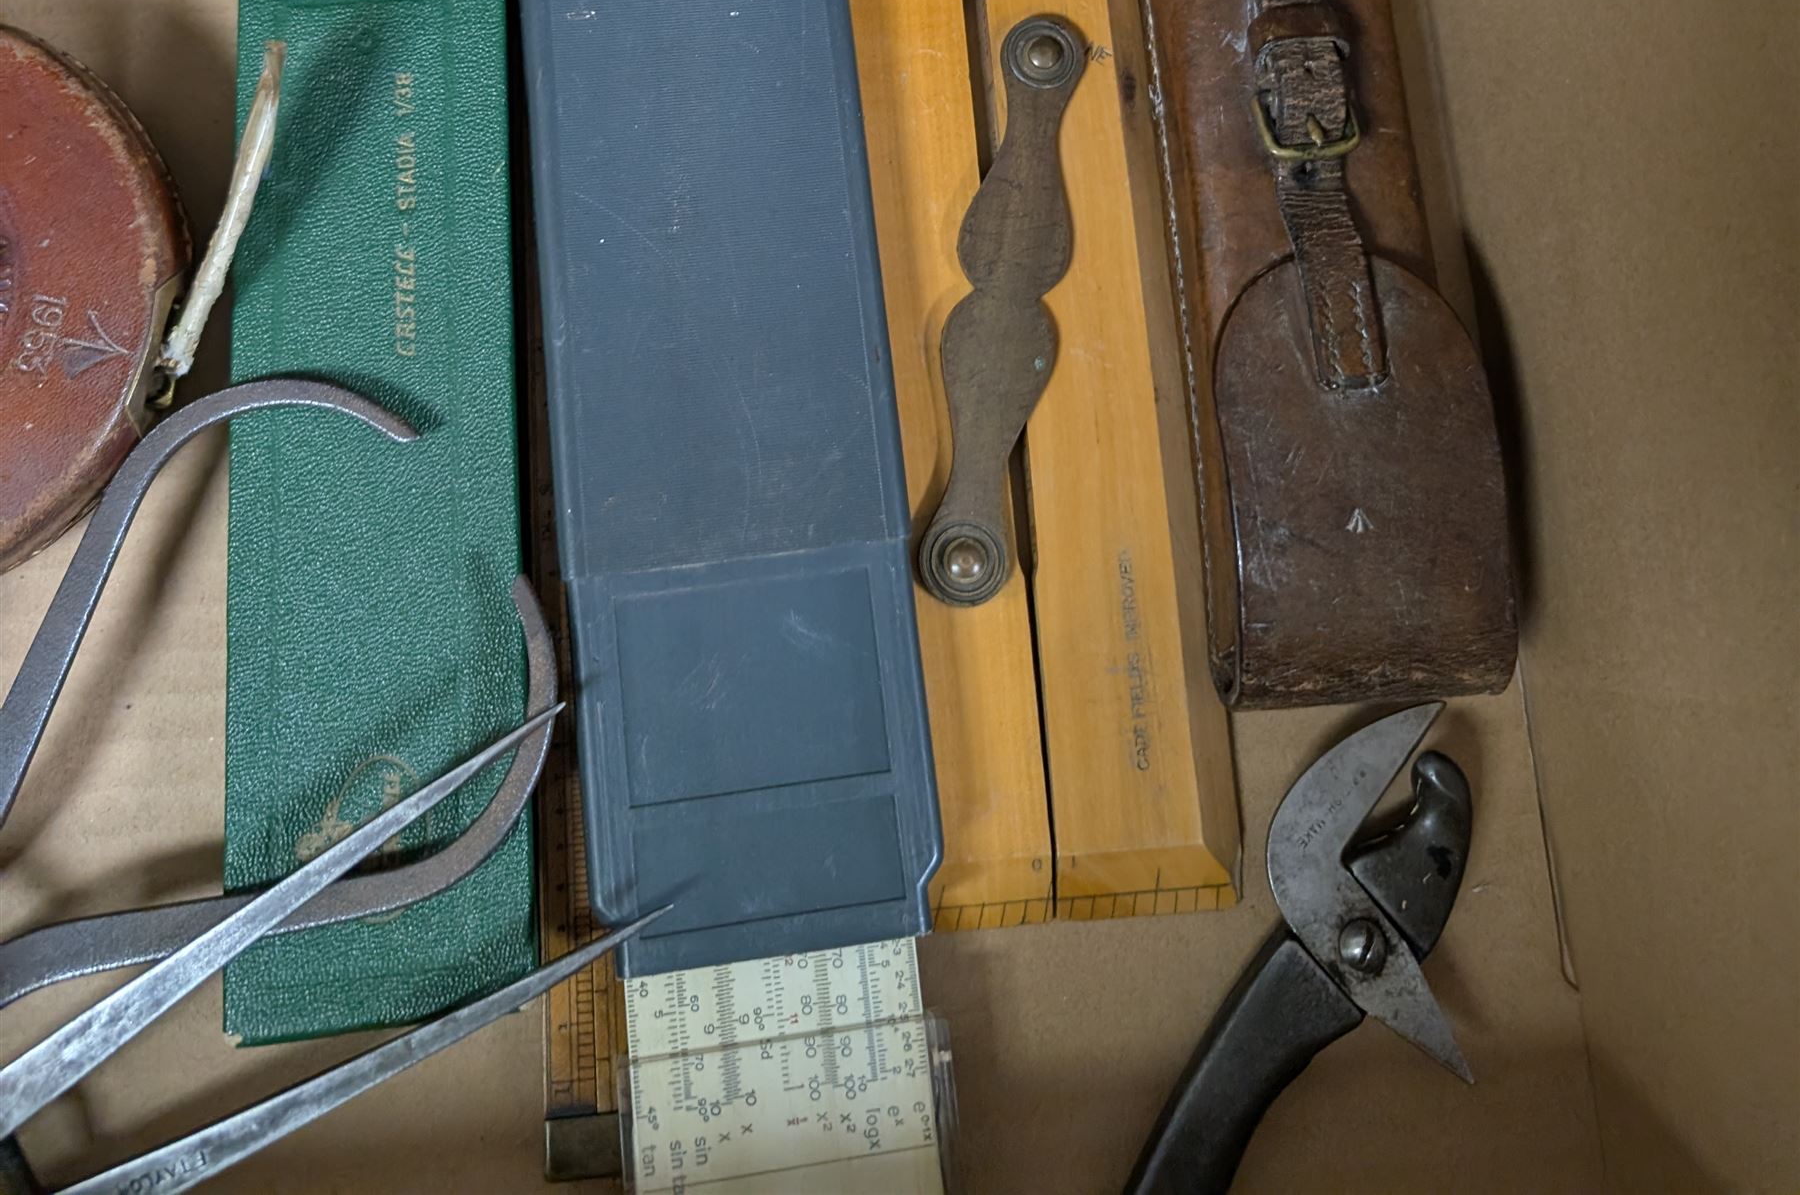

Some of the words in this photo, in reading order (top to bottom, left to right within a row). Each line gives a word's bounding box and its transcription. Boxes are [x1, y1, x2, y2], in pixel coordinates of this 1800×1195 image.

[396, 132, 417, 210] STADIA
[639, 981, 649, 998] 40
[689, 994, 700, 1012] 60
[800, 994, 813, 1016] 80
[835, 994, 849, 1015] 80
[703, 1023, 715, 1035] 9
[804, 1035, 817, 1059] 90
[839, 1035, 853, 1057] 90
[695, 1054, 705, 1072] 70
[738, 1013, 750, 1025] 9
[745, 1088, 758, 1107] 10
[807, 1074, 822, 1101] 100
[843, 1073, 857, 1100] 100
[708, 1099, 722, 1116] 10
[641, 1144, 657, 1178] tan
[669, 1139, 688, 1170] sin
[694, 1136, 713, 1167] sin
[671, 1175, 688, 1195] ta
